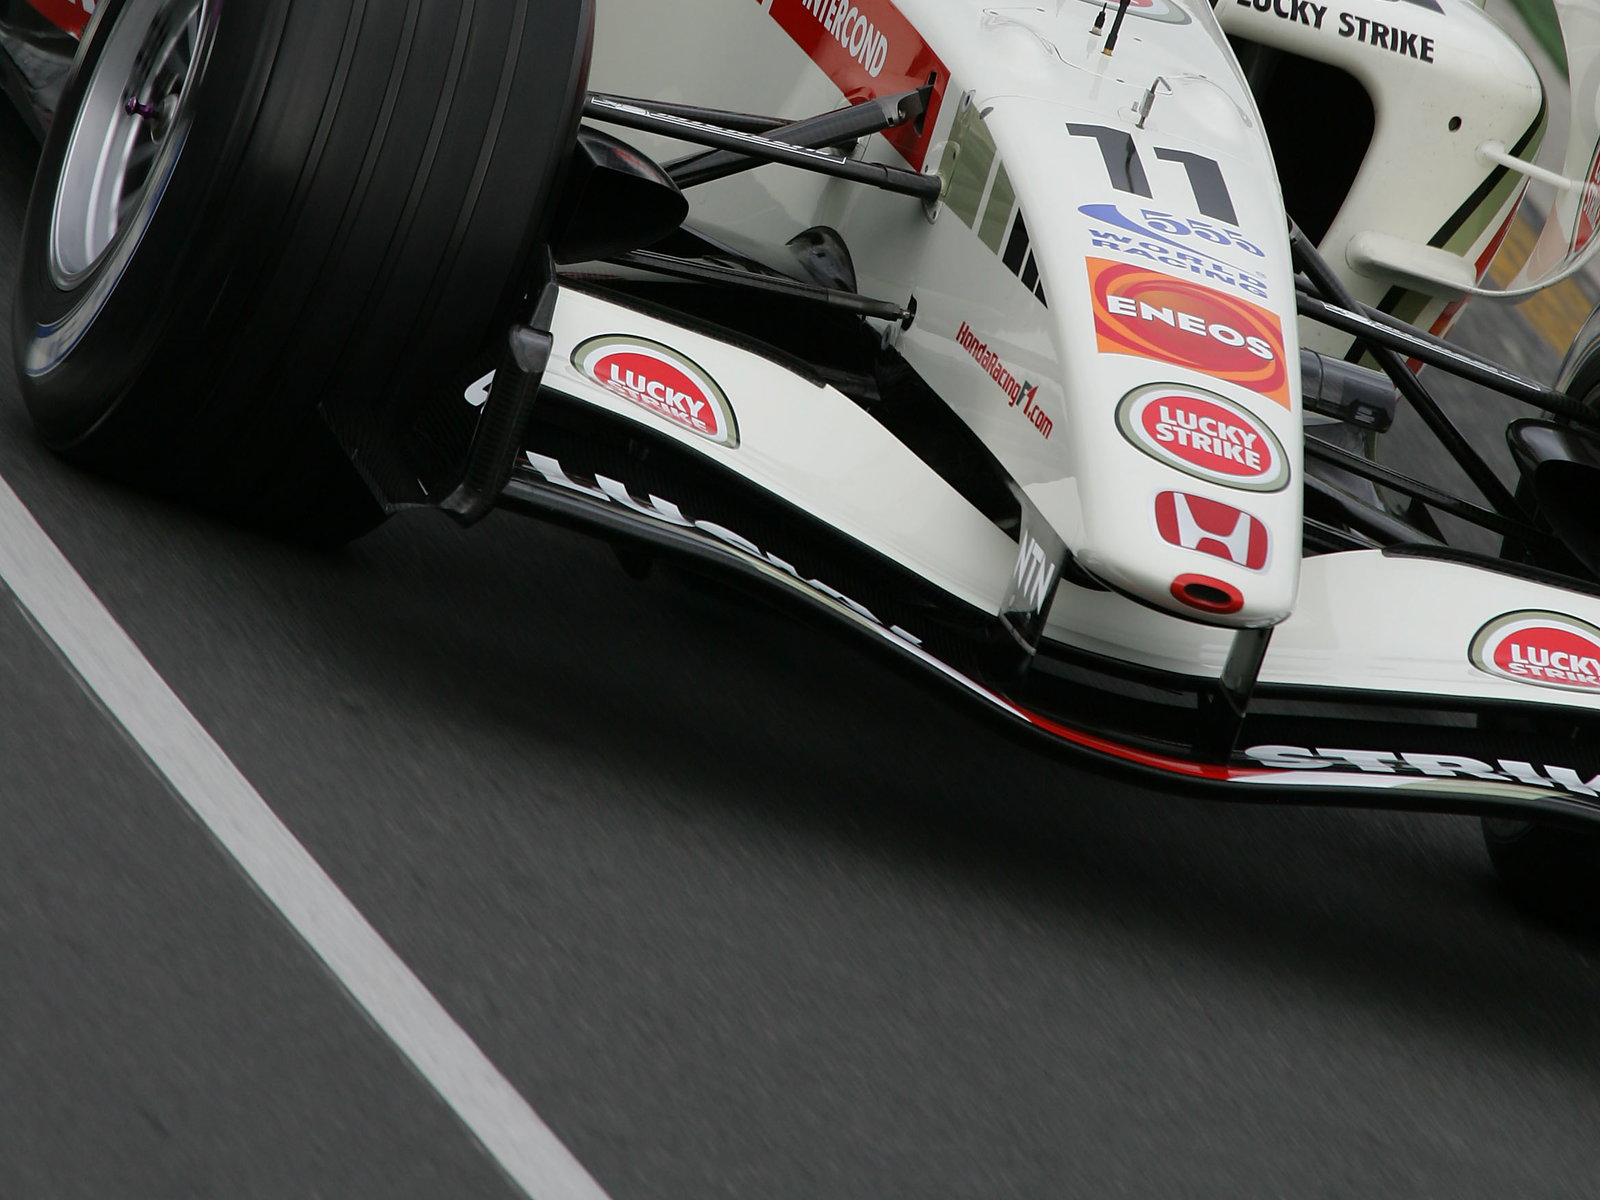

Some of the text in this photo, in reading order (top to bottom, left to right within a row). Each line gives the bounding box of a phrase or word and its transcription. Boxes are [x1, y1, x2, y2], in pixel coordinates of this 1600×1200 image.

[1338, 11, 1435, 64] STRIKE
[1065, 122, 1240, 227] 11
[1087, 228, 1268, 290] WORLD
[1140, 208, 1266, 257] 555
[1091, 238, 1269, 299] RACING
[1106, 294, 1275, 361] ENEOS
[606, 379, 709, 433] STRIKE
[610, 362, 705, 419] LUCKY
[1155, 422, 1262, 471] STRIKE
[1158, 404, 1257, 449] LUCKY
[1013, 529, 1056, 615] NTN
[1508, 662, 1600, 686] STRIK
[1245, 744, 1600, 798] STRIK
